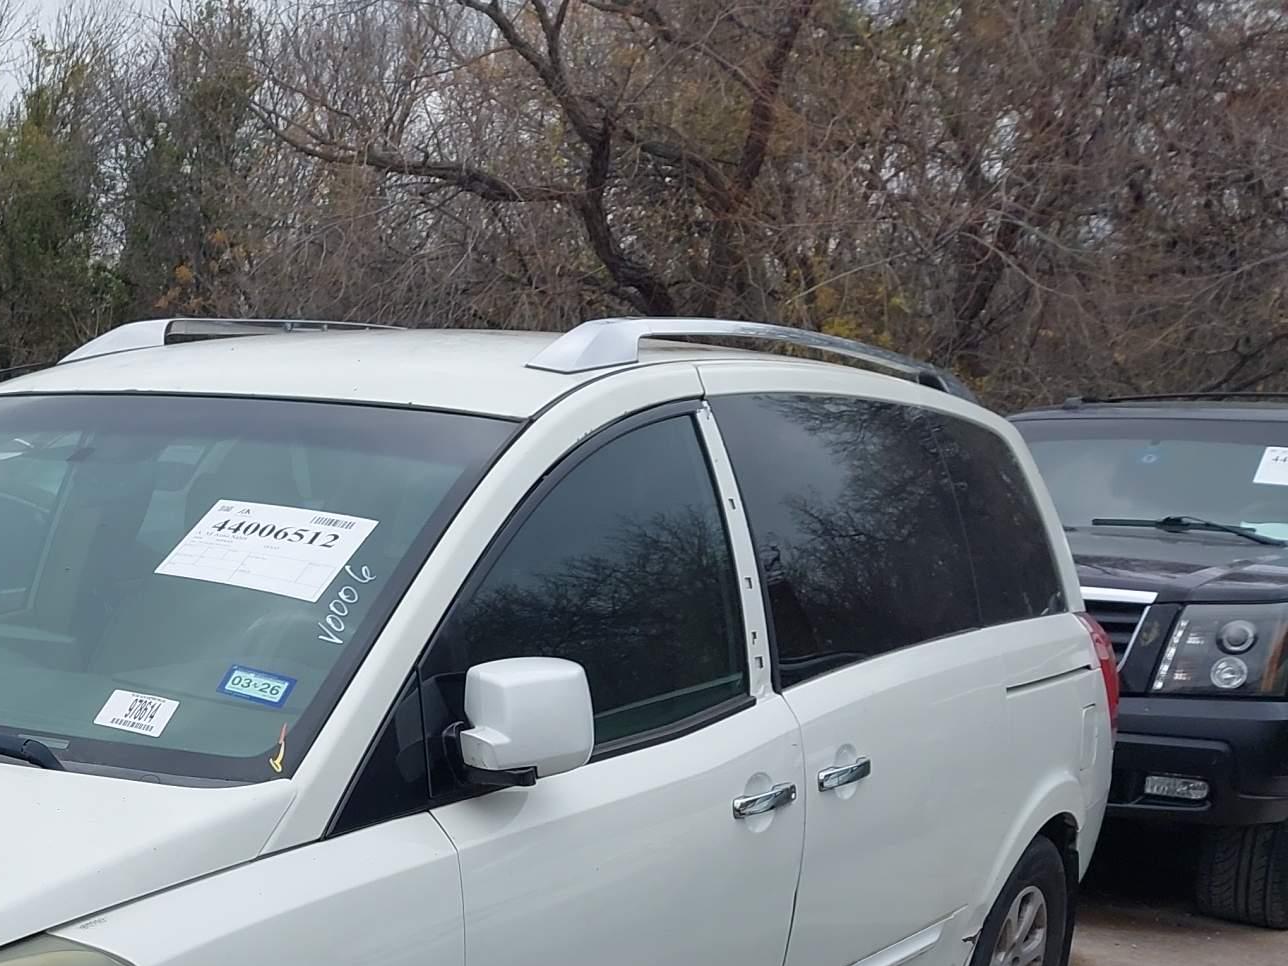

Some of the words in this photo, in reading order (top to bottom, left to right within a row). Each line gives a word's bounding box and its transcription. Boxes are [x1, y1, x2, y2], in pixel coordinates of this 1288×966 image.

[212, 519, 340, 548] 44006512
[231, 676, 253, 688] 03
[259, 683, 281, 696] 26
[124, 698, 162, 723] 978614
